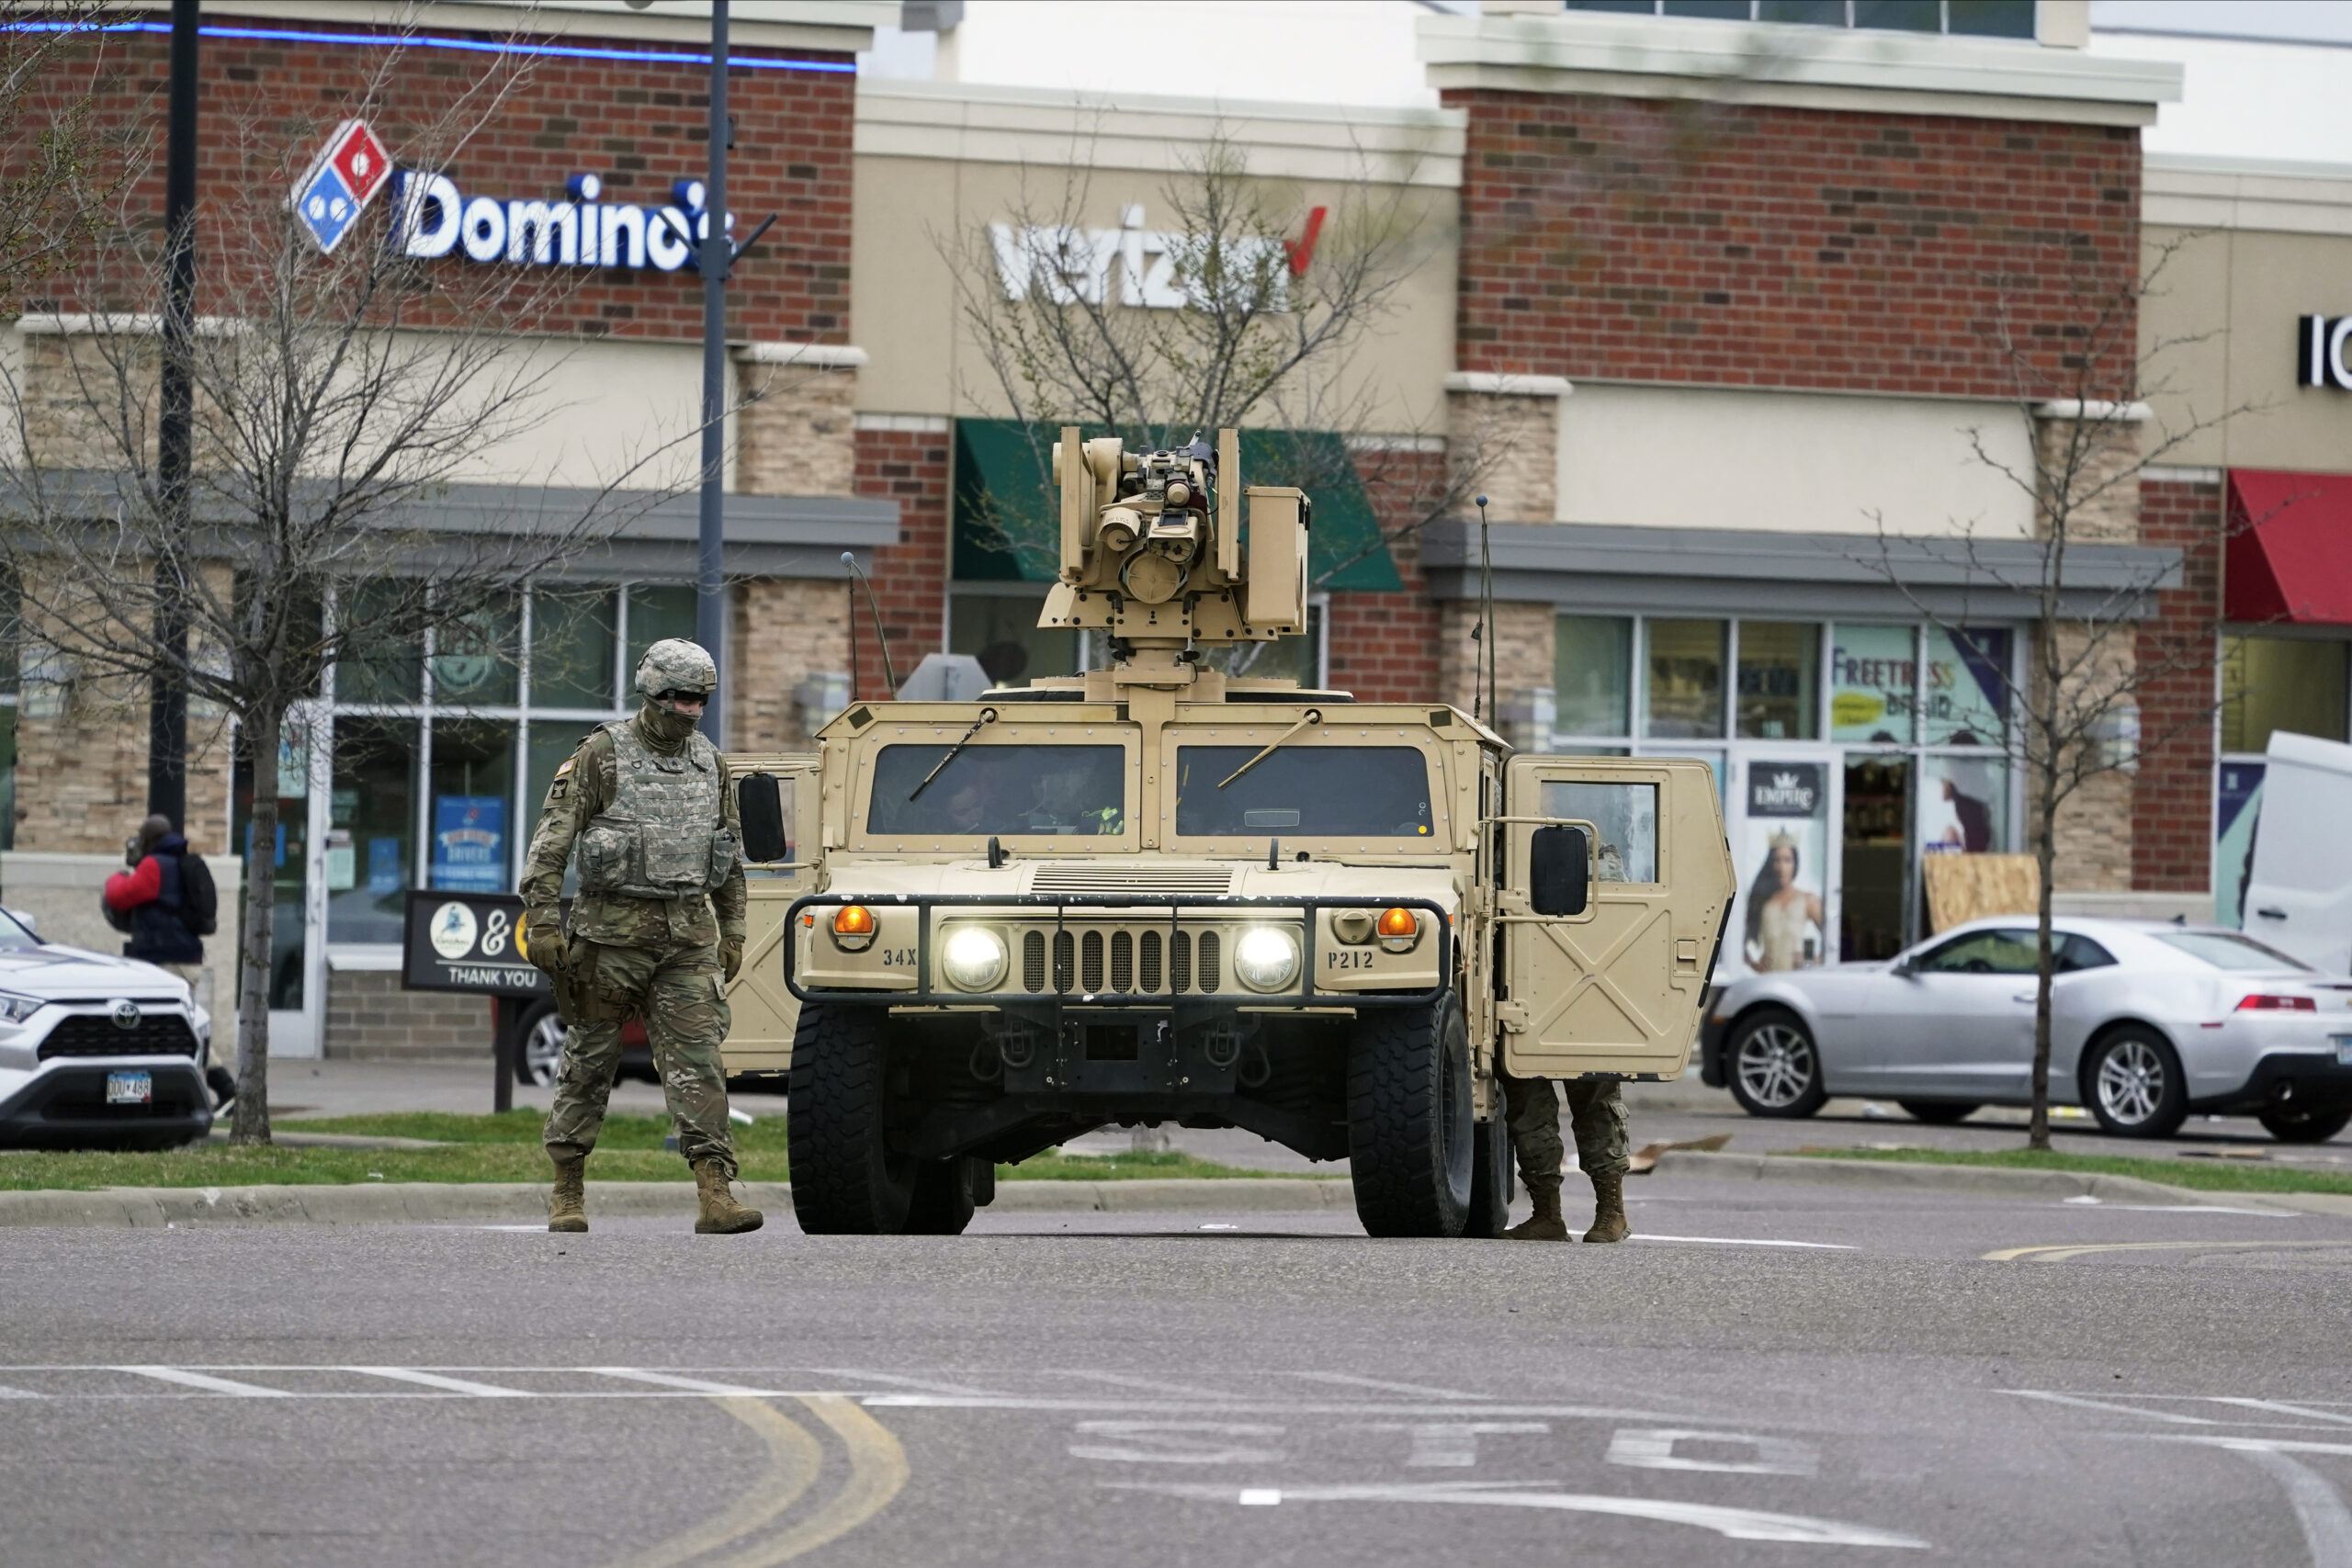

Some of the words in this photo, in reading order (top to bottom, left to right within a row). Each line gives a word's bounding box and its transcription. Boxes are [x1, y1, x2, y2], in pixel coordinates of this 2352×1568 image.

[1831, 646, 1955, 688] FREETRSS
[481, 908, 511, 956] &
[883, 948, 917, 966] 34X
[1328, 951, 1374, 969] P212
[448, 967, 501, 986] THANK
[504, 970, 537, 987] YOU
